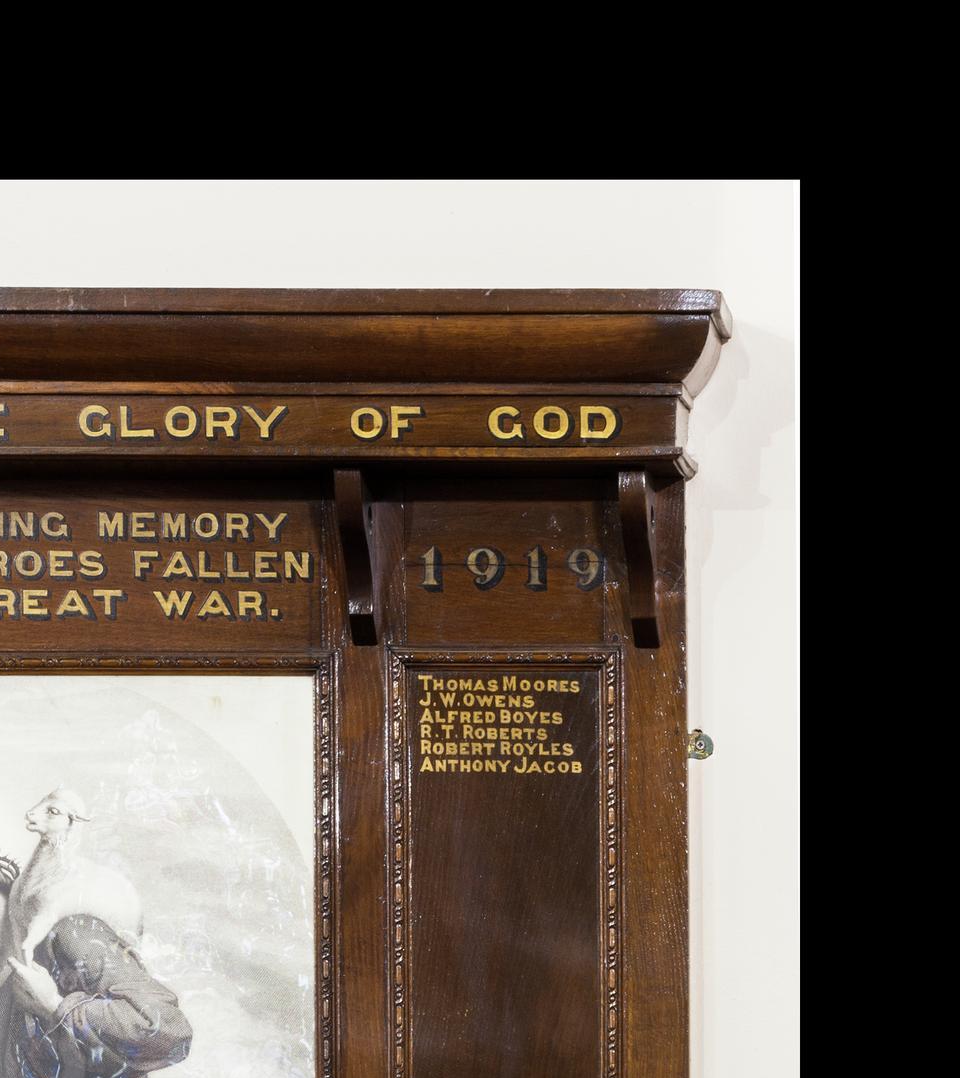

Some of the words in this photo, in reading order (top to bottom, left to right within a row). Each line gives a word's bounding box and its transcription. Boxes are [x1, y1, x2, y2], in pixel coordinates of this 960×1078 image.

[78, 404, 289, 441] GLORY
[350, 405, 426, 441] OF
[488, 405, 622, 442] GOD
[98, 512, 287, 543] MEMORY
[133, 551, 313, 583] FALLEN
[418, 546, 605, 592] 1919
[153, 590, 283, 622] WAR.
[418, 674, 498, 692] THOMAS
[502, 676, 581, 693] MOORES
[463, 693, 535, 708] OWENS
[419, 708, 496, 724] ALFRED
[500, 709, 563, 725] BOYES
[463, 724, 548, 740] ROBERTS
[420, 740, 495, 755] ROBERT
[500, 741, 574, 757] ROYLES
[419, 756, 511, 773] ANTHONY
[514, 756, 583, 774] JACOB
